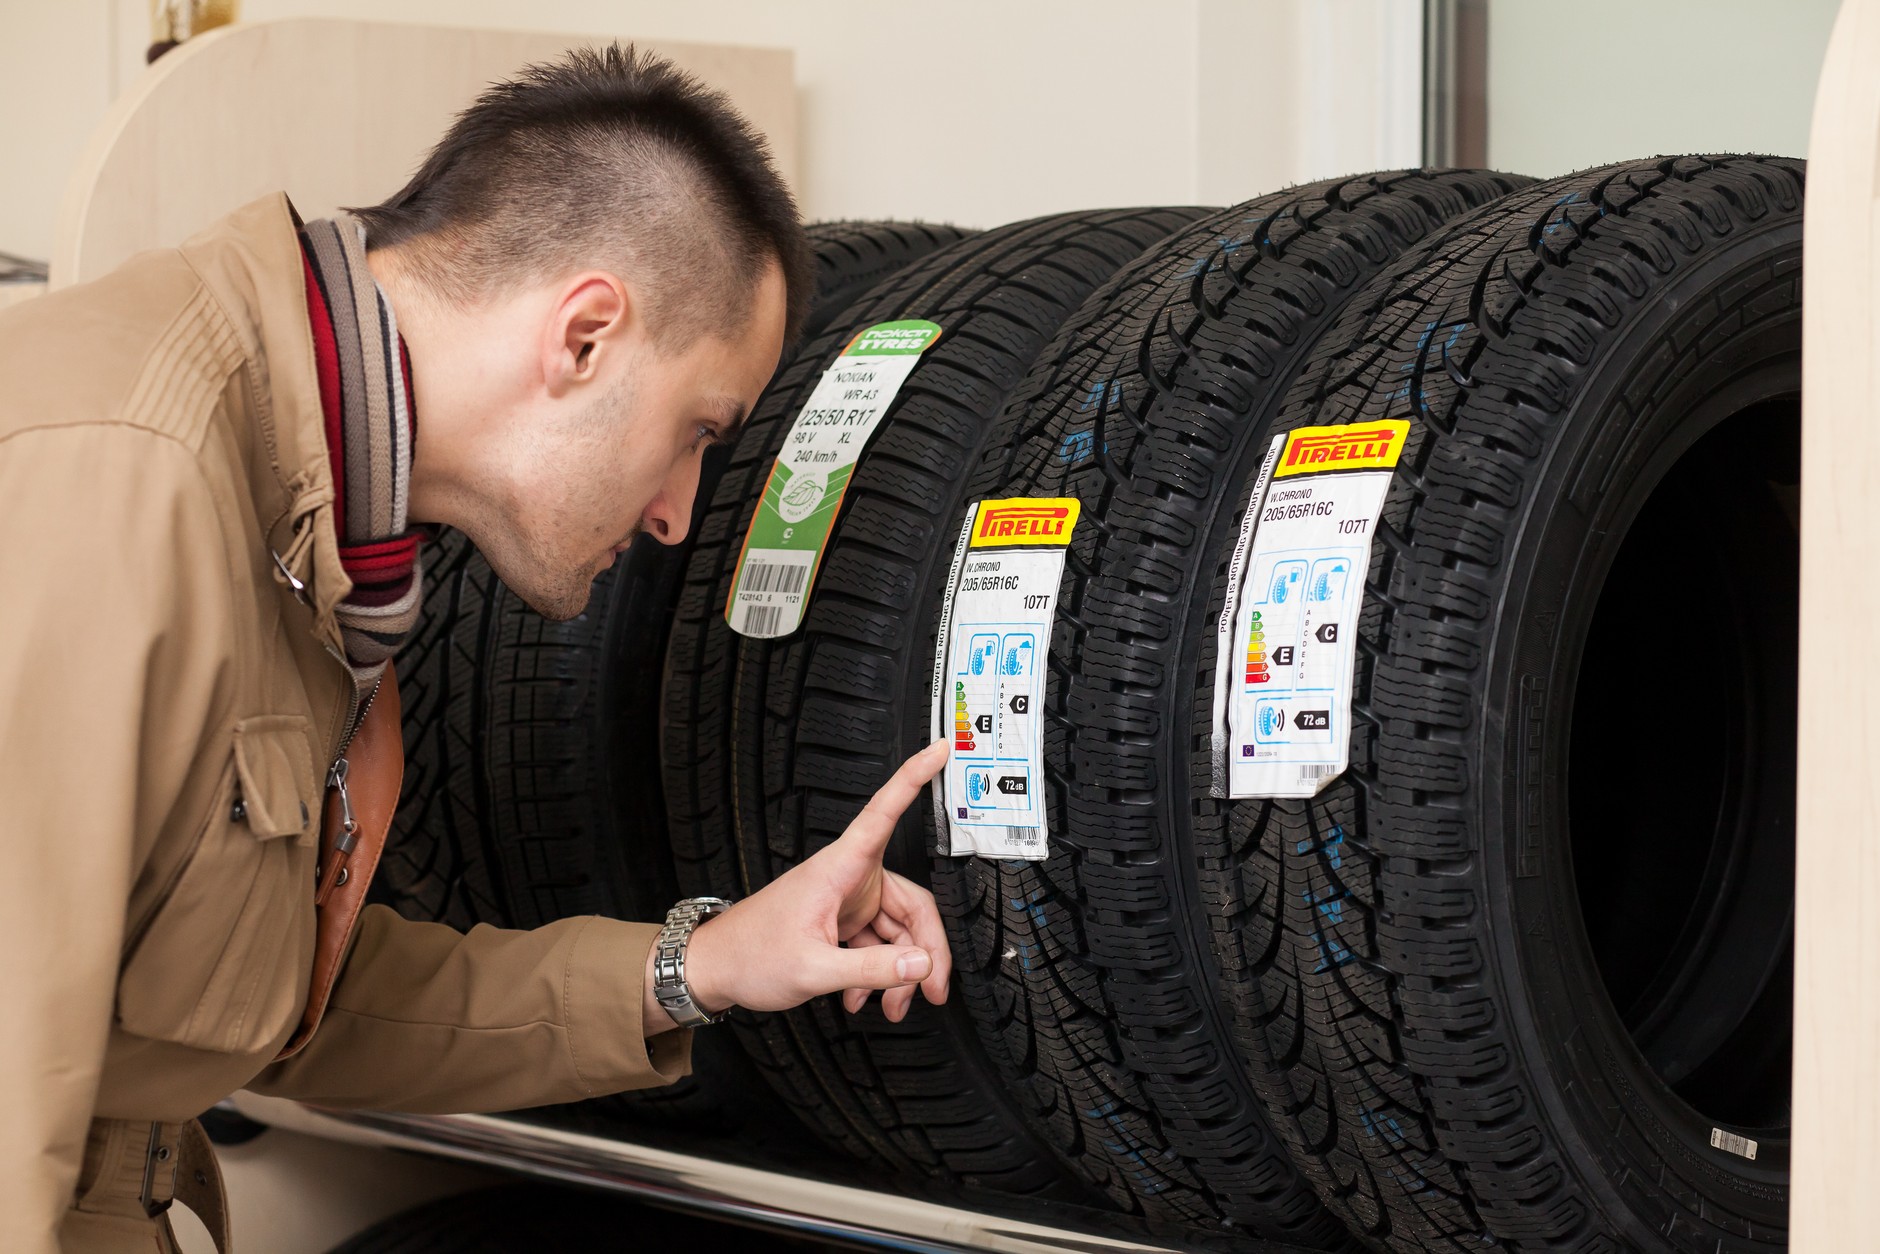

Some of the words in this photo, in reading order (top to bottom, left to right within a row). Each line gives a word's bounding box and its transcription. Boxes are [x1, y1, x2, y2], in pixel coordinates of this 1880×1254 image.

[858, 338, 925, 350] TYRES
[834, 372, 876, 383] NOKIAN
[843, 389, 861, 400] WR
[862, 390, 878, 400] A3
[843, 409, 876, 426] R17
[792, 432, 807, 444] 98
[808, 432, 817, 444] V
[838, 432, 852, 444] XL
[1286, 429, 1396, 467] PIRELLI
[793, 450, 812, 462] 240
[812, 450, 838, 462] km/h
[1256, 445, 1278, 489] CONTROL
[1270, 488, 1312, 504] W.CHRONO
[1242, 492, 1260, 535] WITHOUT
[1263, 501, 1334, 522] 205/65R16C
[979, 508, 1070, 538] PIRELLI
[1338, 518, 1370, 534] 107T
[956, 516, 972, 557] CONTROL
[966, 561, 1000, 573] W.CHRONO
[1231, 537, 1247, 582] NOTHING
[945, 560, 959, 603] WITHOUT
[962, 576, 1019, 592] 205/65R16C
[1229, 582, 1236, 594] IS
[785, 595, 800, 604] 1121
[1024, 595, 1050, 610] 107T
[1220, 596, 1233, 633] POWER
[938, 604, 950, 647] NOTHING
[1324, 626, 1335, 640] C
[937, 650, 943, 659] IS
[1280, 648, 1290, 663] E
[933, 662, 942, 698] POWER
[1016, 698, 1026, 710] C
[982, 716, 990, 730] E
[1303, 714, 1314, 726] 72
[1315, 717, 1326, 726] dB
